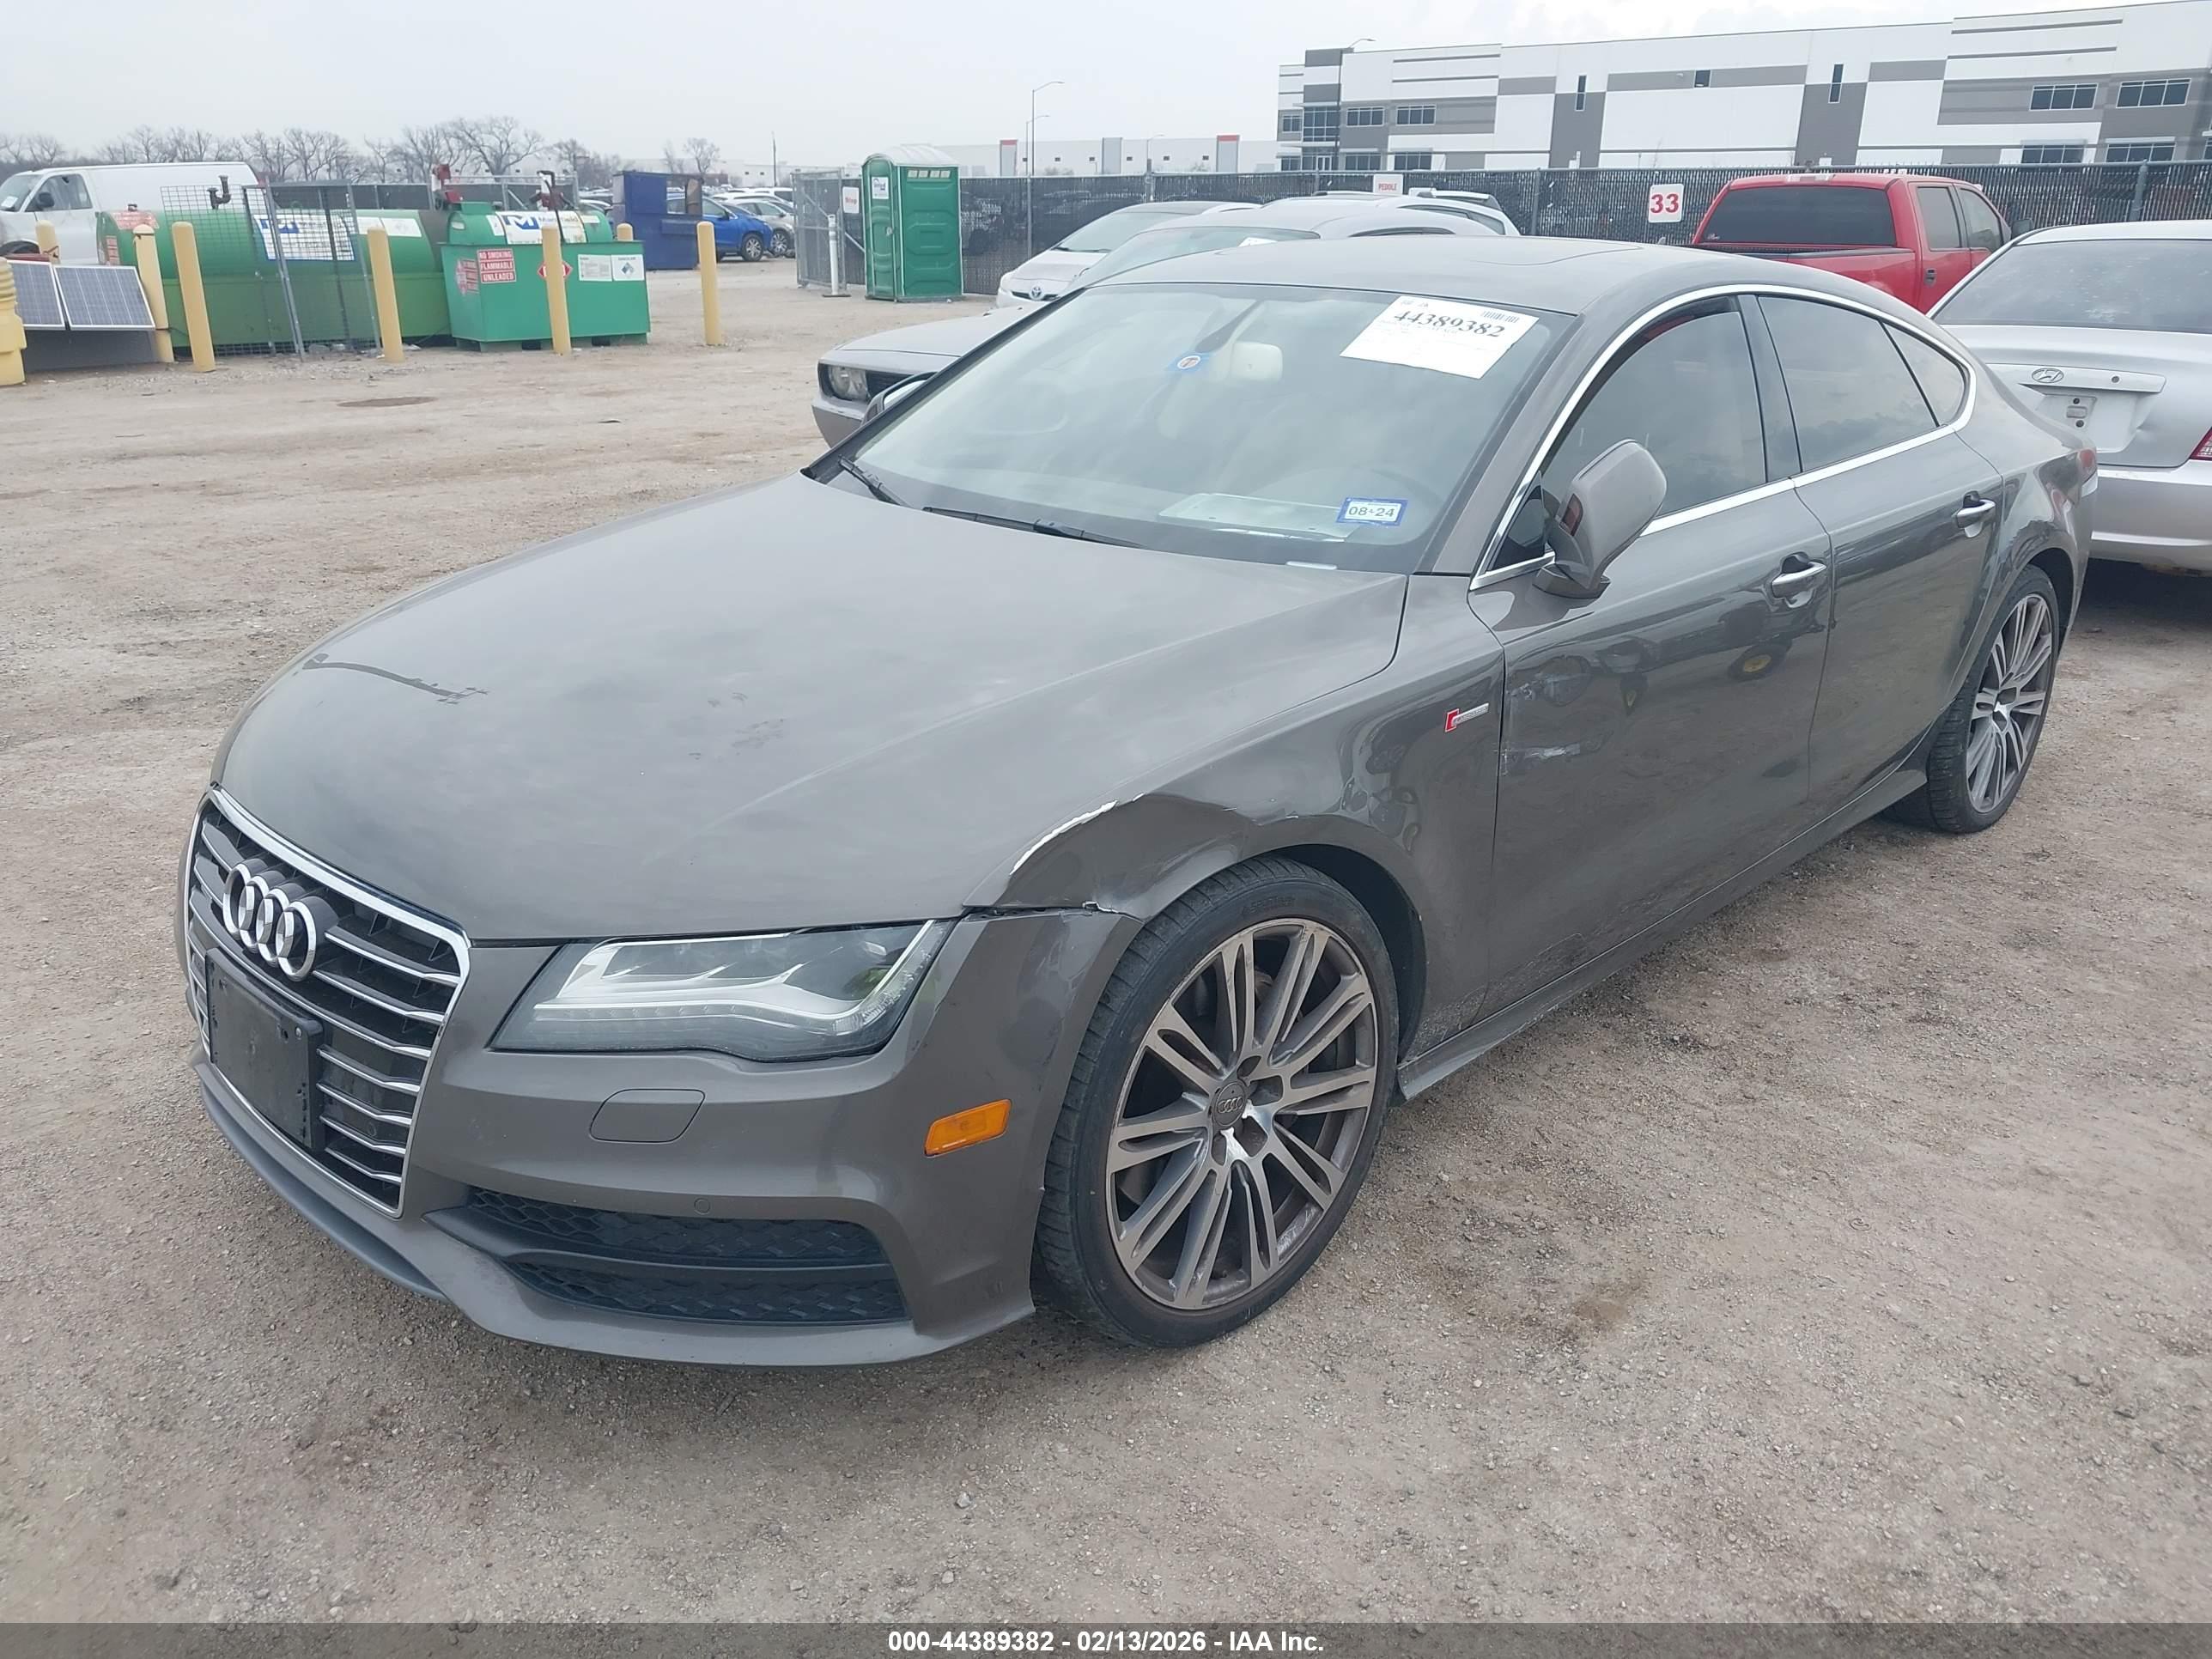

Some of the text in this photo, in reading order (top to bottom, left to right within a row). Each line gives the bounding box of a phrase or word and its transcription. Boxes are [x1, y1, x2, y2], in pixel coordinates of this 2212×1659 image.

[1650, 194, 1679, 213] 33
[480, 260, 514, 270] FLAMMABLE
[483, 272, 514, 281] UNLEADED
[1394, 310, 1505, 337] 44389382
